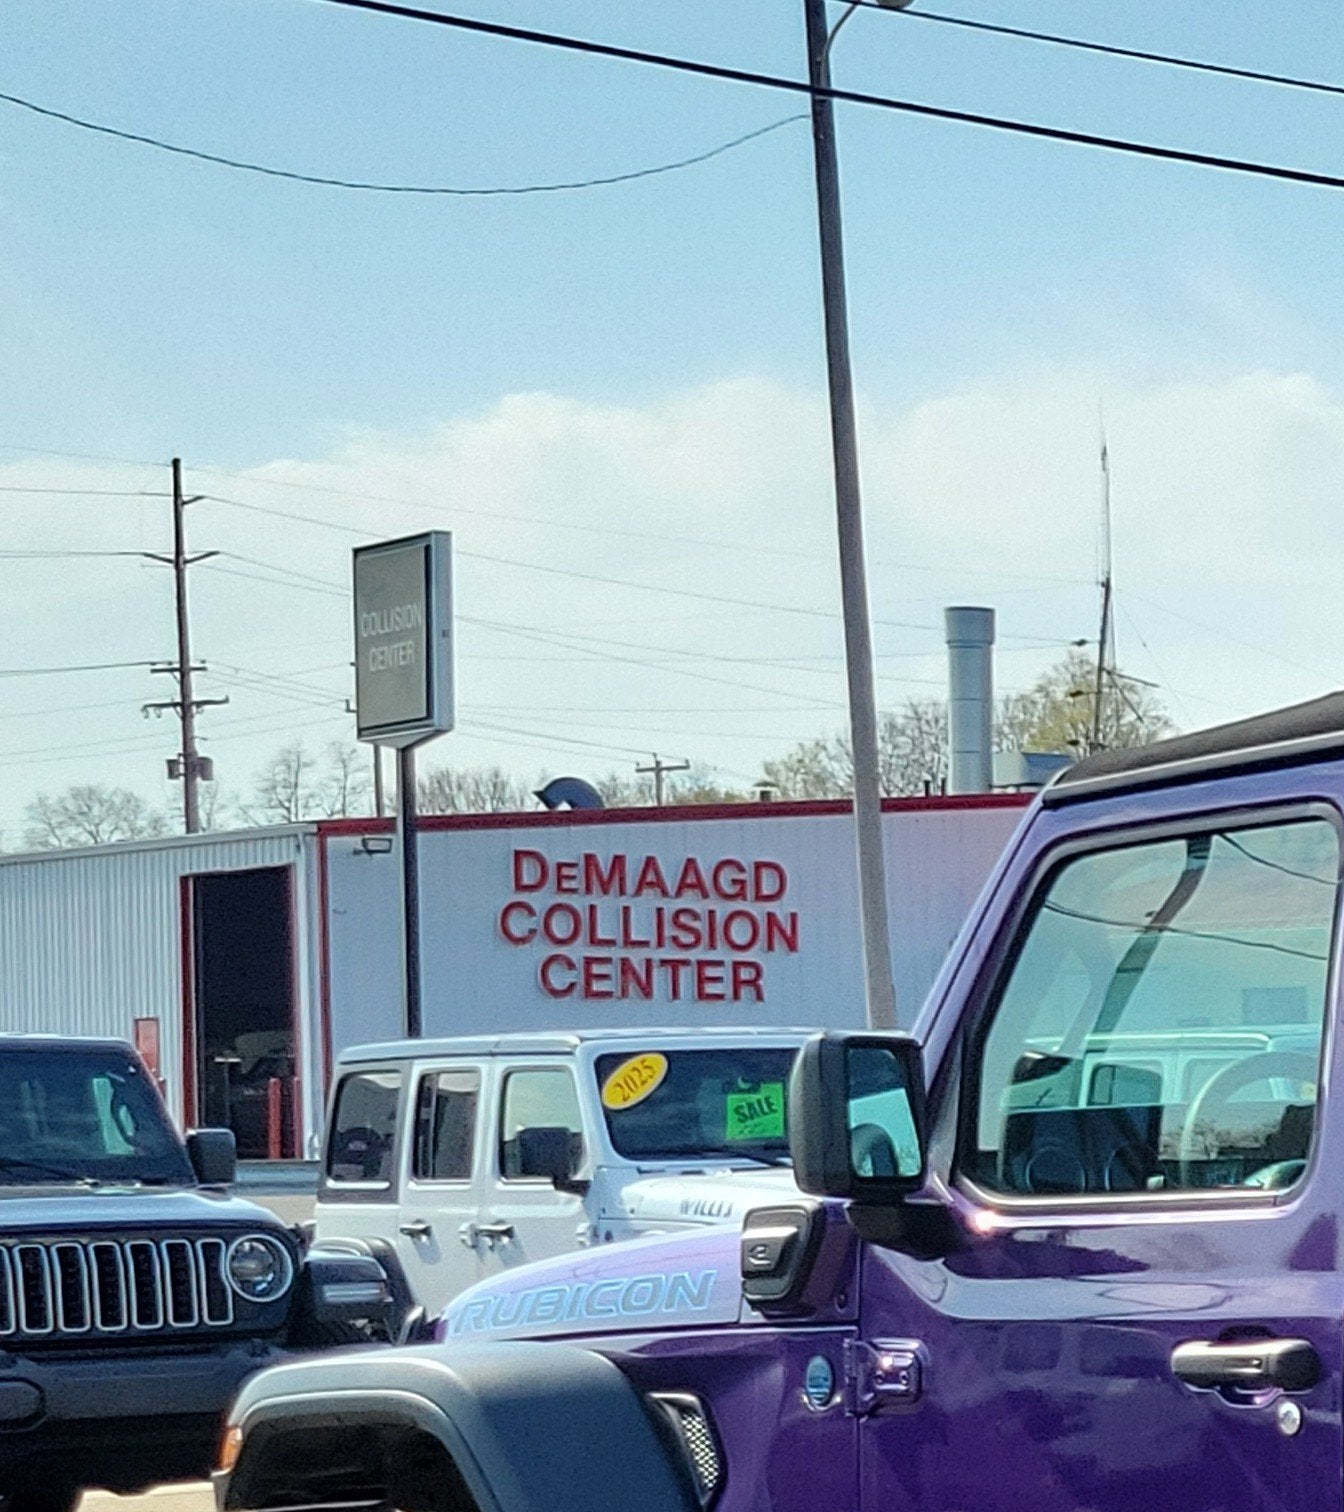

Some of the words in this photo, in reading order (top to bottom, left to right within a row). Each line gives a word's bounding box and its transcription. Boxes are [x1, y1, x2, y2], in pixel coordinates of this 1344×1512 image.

[361, 603, 422, 637] COLLISION
[369, 640, 415, 671] CENTER
[500, 900, 799, 953] COLLISION
[539, 953, 764, 1002] CENTER
[612, 1059, 656, 1102] 2025
[733, 1096, 778, 1123] SALE
[455, 1270, 717, 1334] RUBICON
